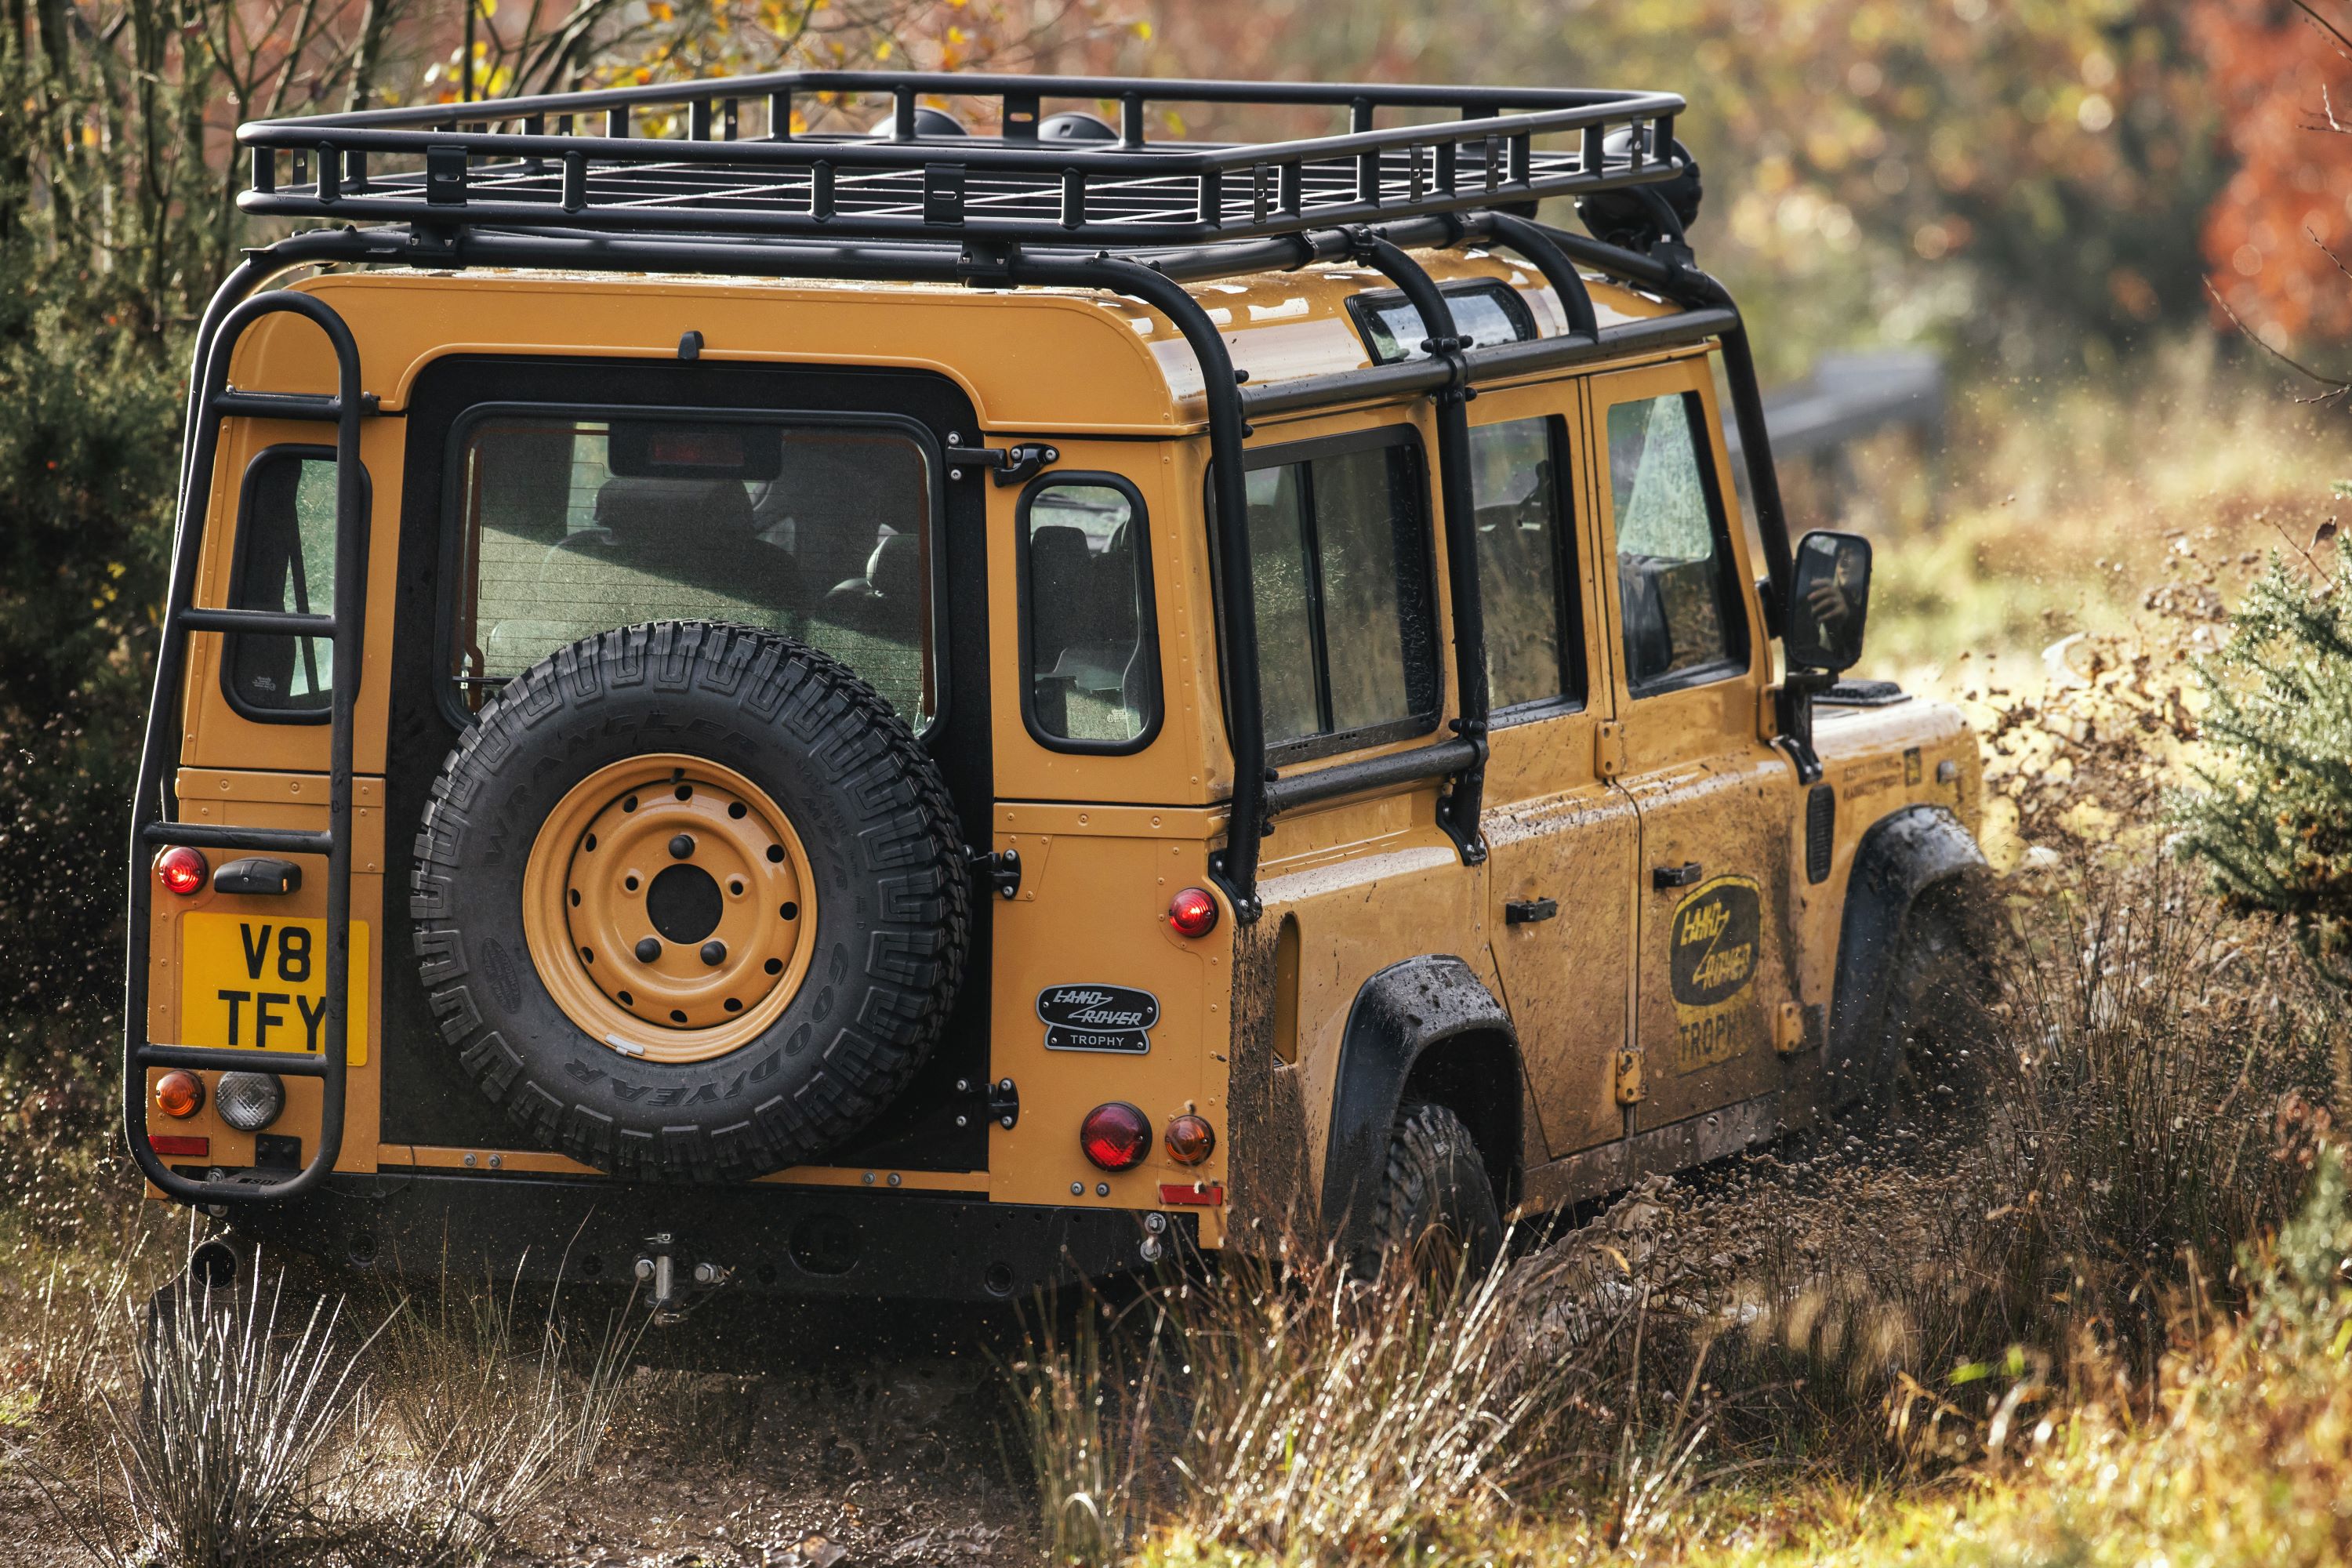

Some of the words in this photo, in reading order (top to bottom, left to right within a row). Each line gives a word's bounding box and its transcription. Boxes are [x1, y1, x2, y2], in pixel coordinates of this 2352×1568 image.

[481, 712, 764, 867] WRANGLER
[1680, 902, 1722, 946] LAND
[240, 923, 311, 982] V8
[218, 989, 326, 1051] TFY
[564, 942, 848, 1106] GOODYEAR
[1053, 990, 1103, 1004] LAND
[1080, 1010, 1142, 1025] ROVER
[1070, 1034, 1125, 1047] TROPHY
[1679, 1008, 1747, 1062] TROPH
